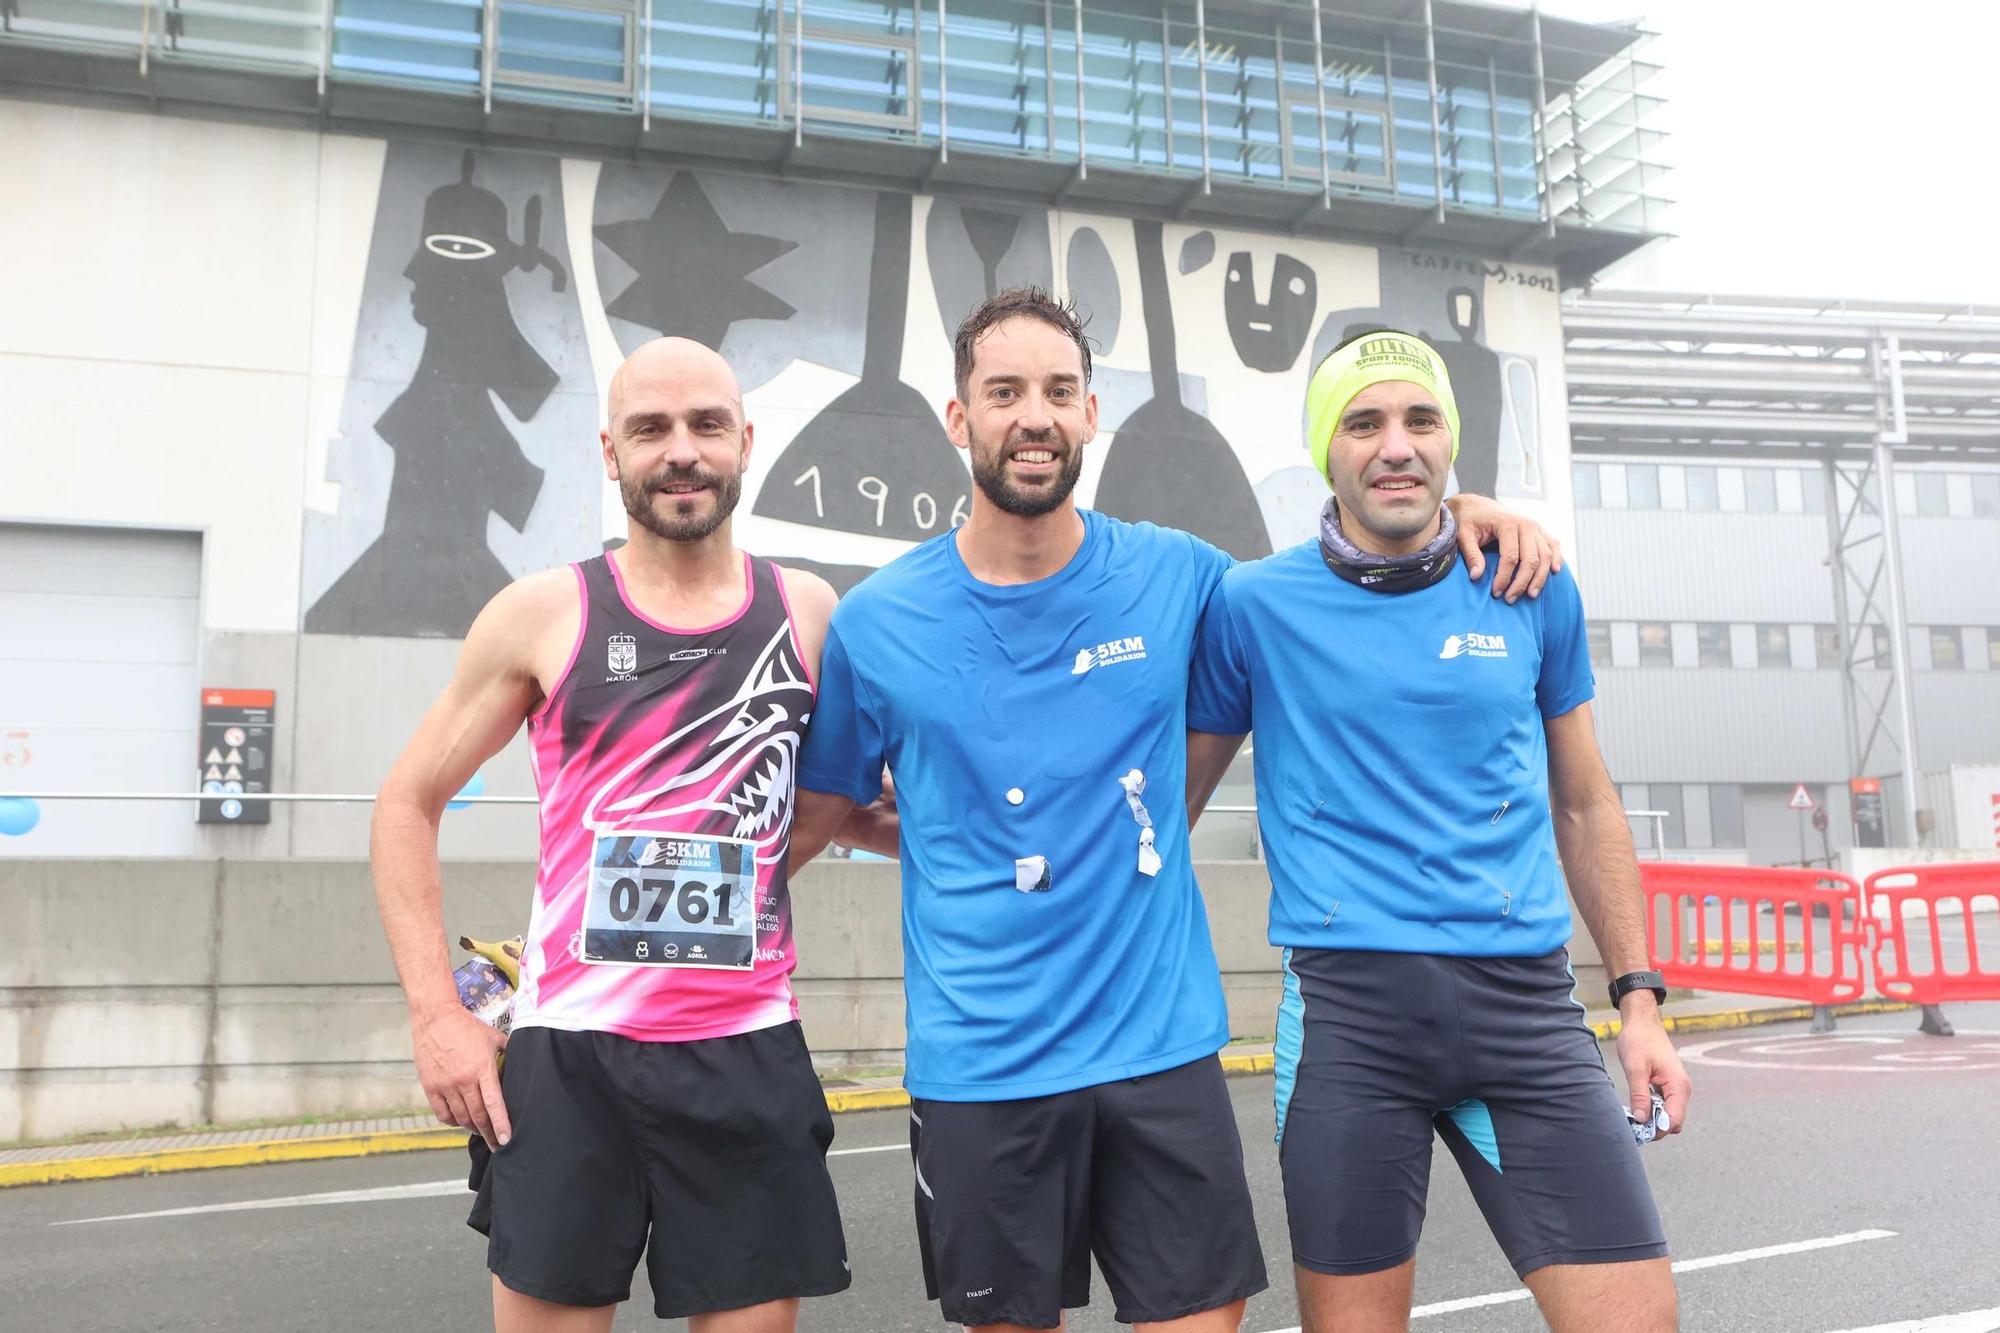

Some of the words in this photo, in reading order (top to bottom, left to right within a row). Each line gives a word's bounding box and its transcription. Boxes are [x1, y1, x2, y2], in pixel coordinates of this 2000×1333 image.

[1355, 355, 1390, 367] SPORT
[794, 465, 969, 529] 1906
[1097, 636, 1145, 659] 5KM
[1467, 633, 1506, 649] 5KM
[666, 841, 711, 859] 5KM
[609, 877, 734, 926] 0761
[756, 912, 779, 923] EPORTE
[757, 922, 779, 932] ALEGO
[754, 947, 785, 960] ANCA
[966, 1287, 993, 1298] EVADICT
